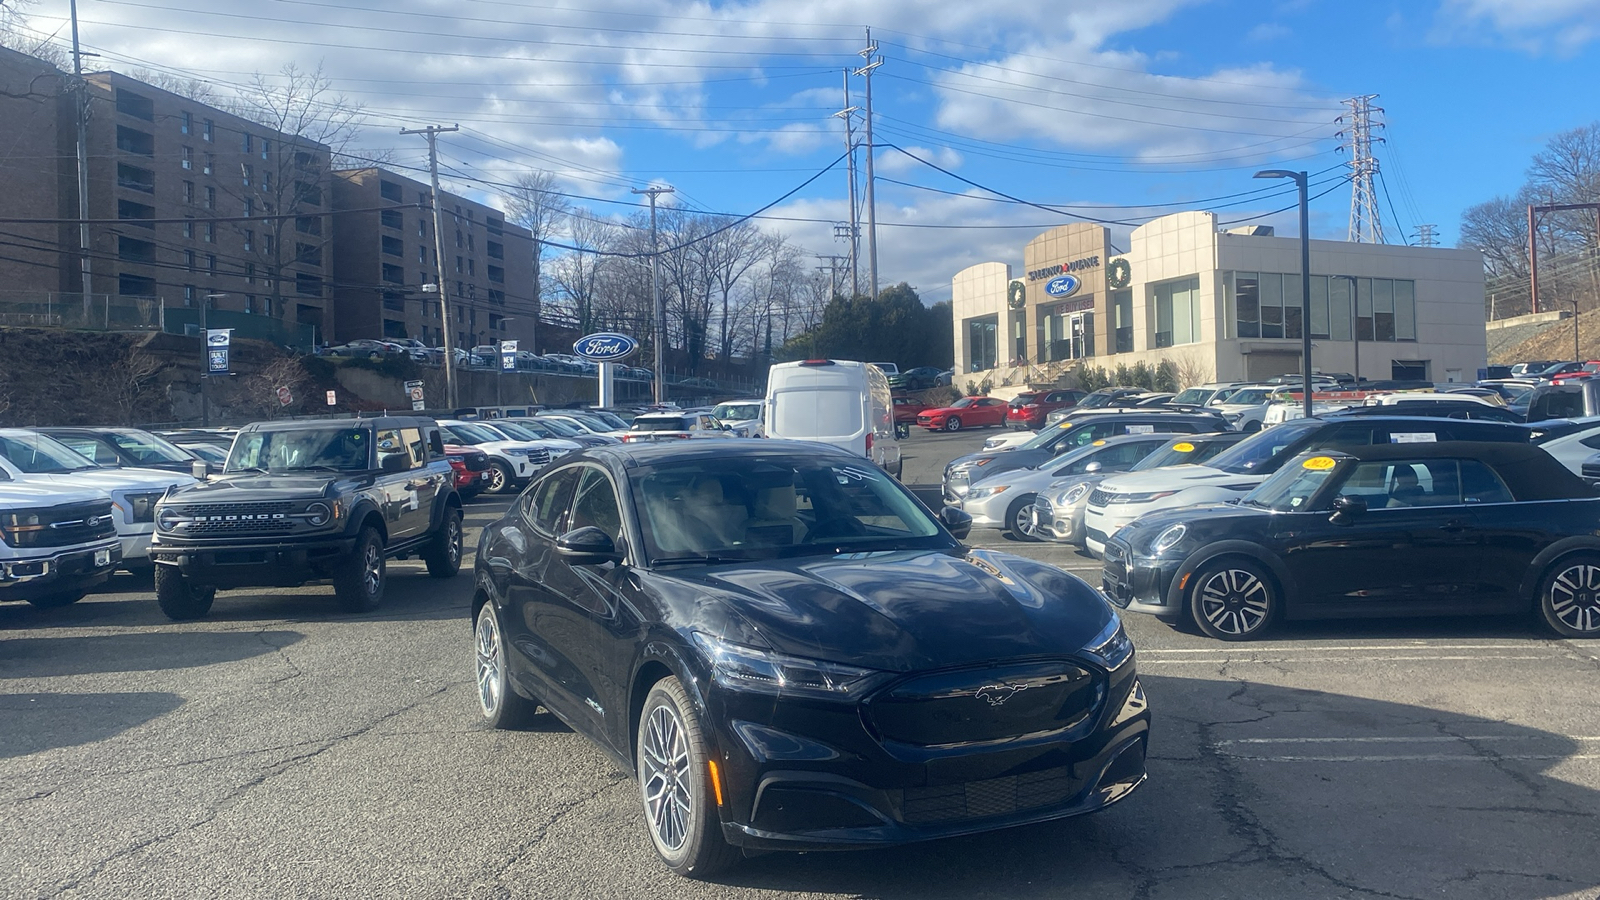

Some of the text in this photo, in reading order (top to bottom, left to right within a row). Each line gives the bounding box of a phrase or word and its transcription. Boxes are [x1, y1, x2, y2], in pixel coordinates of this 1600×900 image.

[1050, 279, 1070, 294] Ford
[1055, 304, 1065, 315] WE
[1065, 302, 1078, 313] BUY
[586, 338, 621, 355] Ford
[194, 513, 285, 521] BRONCO
